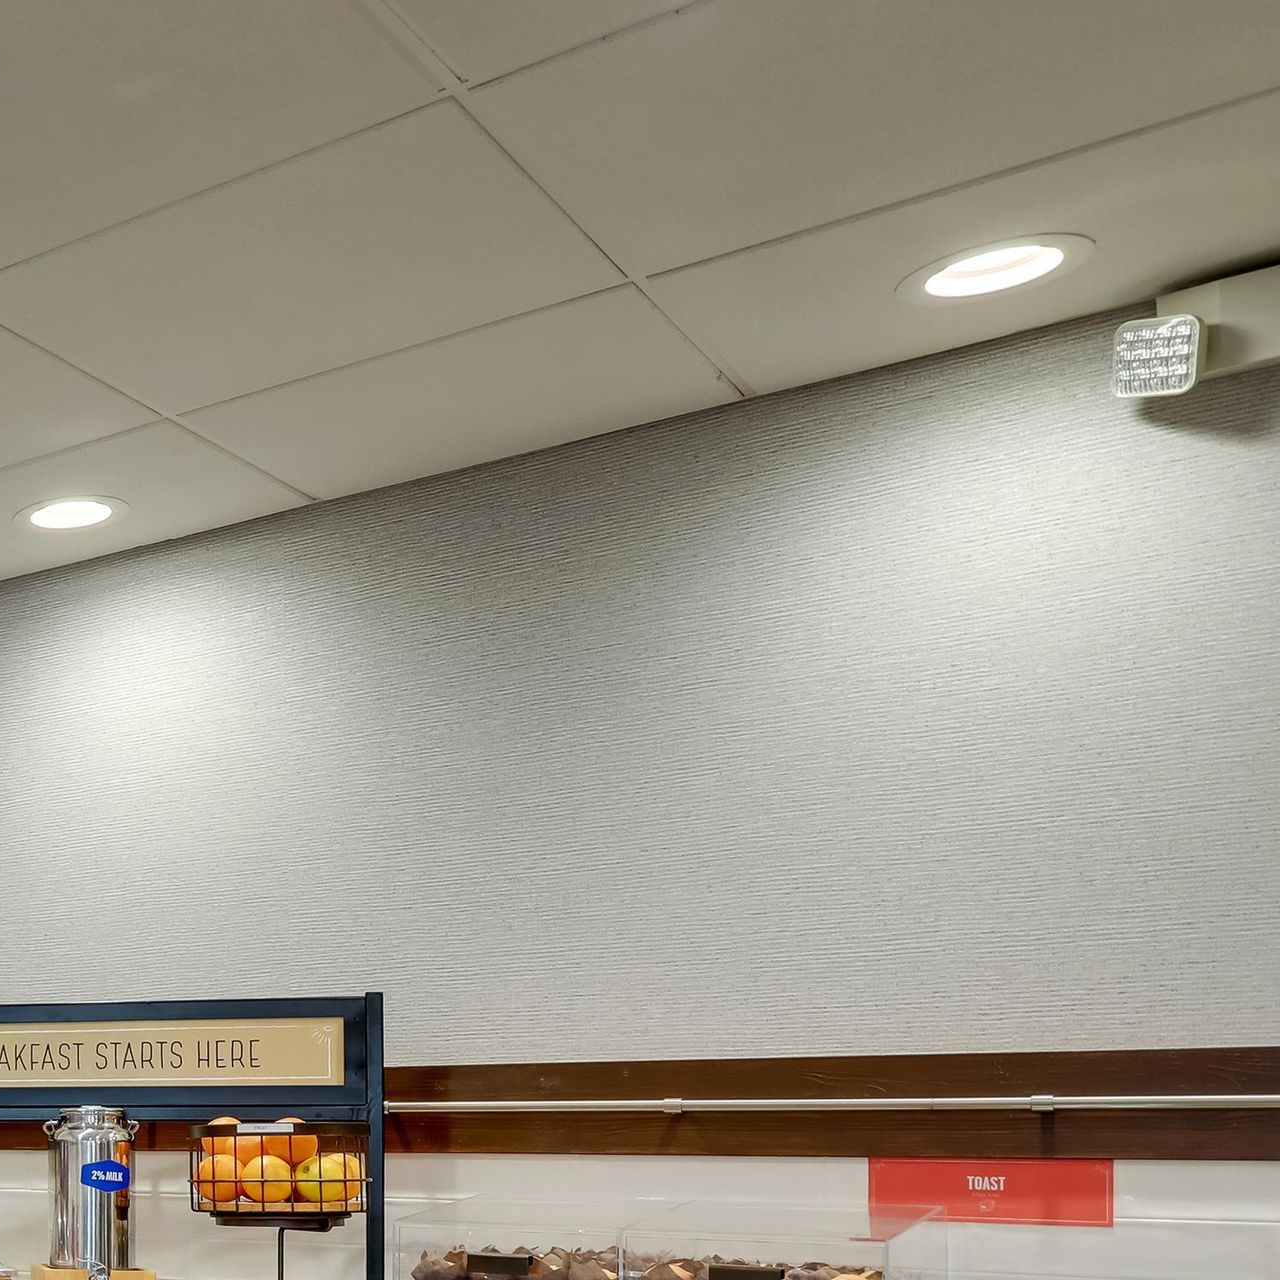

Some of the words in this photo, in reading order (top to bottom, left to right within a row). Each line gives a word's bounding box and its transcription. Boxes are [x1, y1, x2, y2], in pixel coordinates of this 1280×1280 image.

[95, 1040, 183, 1070] STARTS
[197, 1038, 261, 1069] HERE
[91, 1170, 105, 1180] 2%
[105, 1171, 123, 1182] MILK
[967, 1175, 1006, 1191] TOAST
